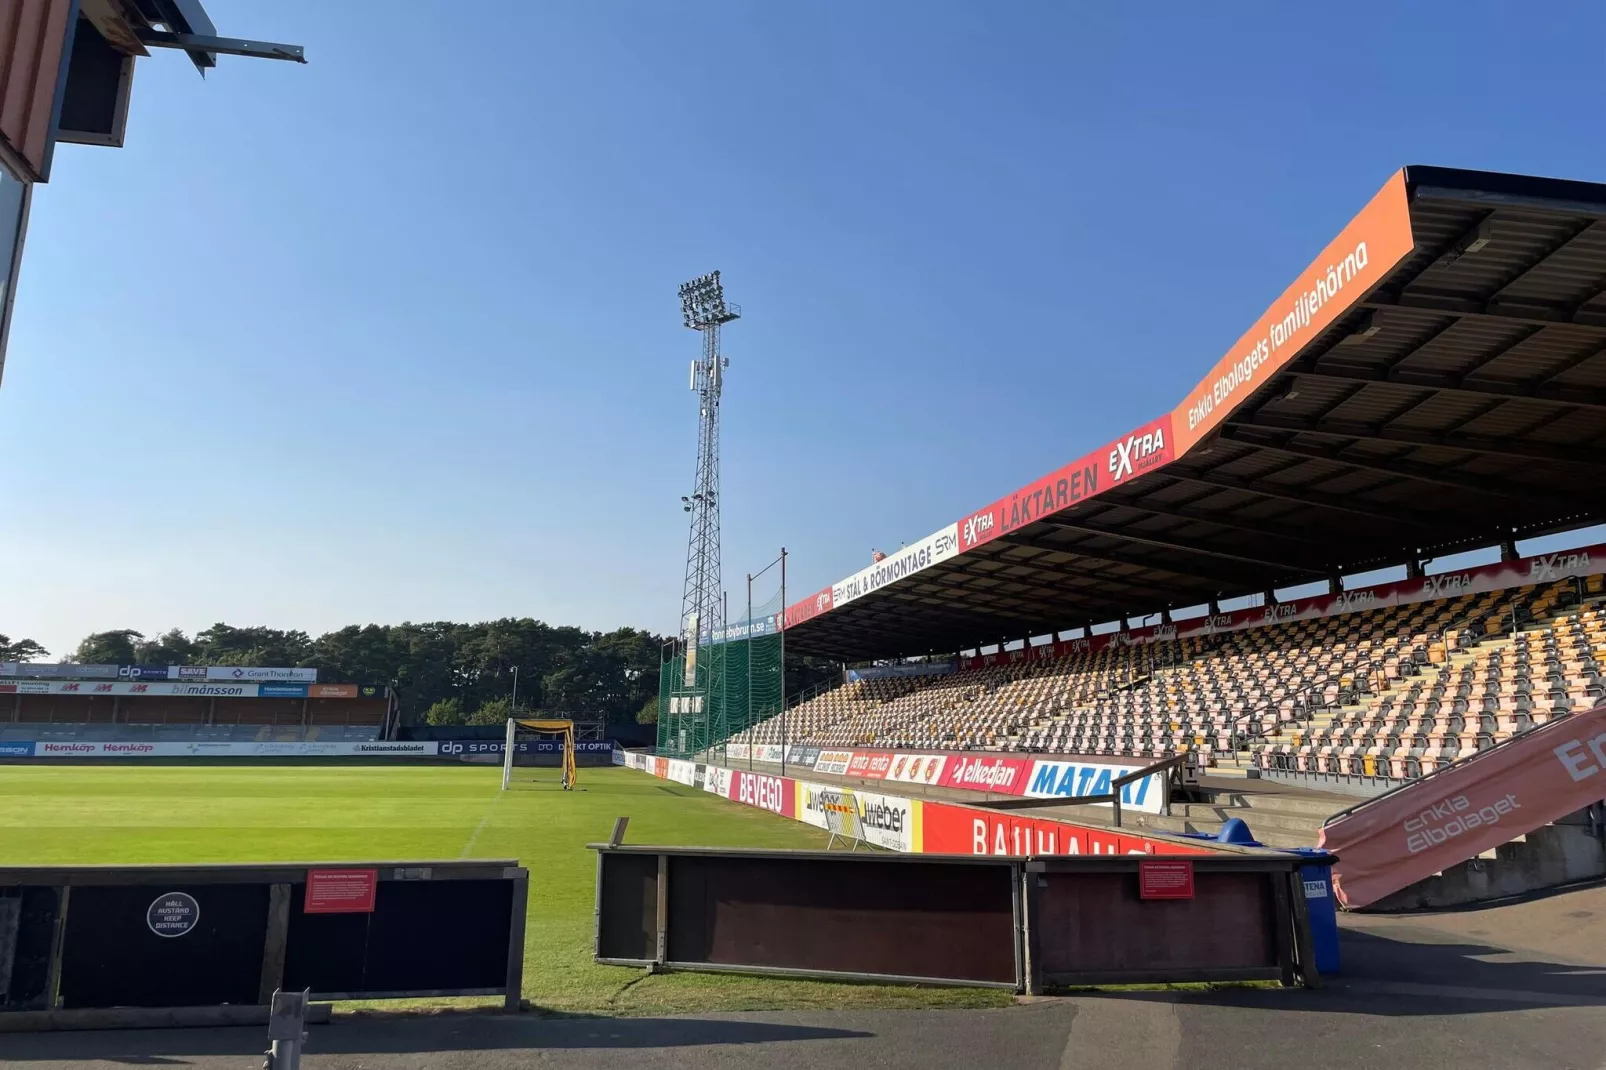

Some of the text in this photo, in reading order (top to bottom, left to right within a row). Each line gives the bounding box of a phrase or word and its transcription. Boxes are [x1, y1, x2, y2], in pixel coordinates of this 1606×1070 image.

[1189, 241, 1369, 431] Enkla Elbolagets familjehörna
[964, 428, 1165, 546] EXTRA LÄKTAREN EXTRA
[847, 577, 861, 600] STÅL
[863, 576, 869, 592] &
[870, 546, 932, 590] RÖRMONTAGE
[935, 533, 957, 556] SRM
[1530, 552, 1591, 581] EXTRA
[1422, 573, 1472, 599] EXTRA
[1336, 590, 1375, 612] EXTRA
[1204, 614, 1232, 633] EXTRA
[1264, 604, 1297, 624] EXTRA
[1154, 624, 1177, 640] EXTRA
[119, 665, 141, 678] dp
[180, 667, 206, 675] SAVE
[45, 744, 96, 752] Hemköp
[103, 744, 154, 752] Hemköp
[442, 741, 463, 754] dp
[588, 743, 611, 751] OPTIK
[964, 759, 1018, 789] elkedjan
[739, 773, 783, 814] BEVEGO
[866, 797, 906, 833] weber
[1403, 794, 1470, 833] Enkla
[1406, 793, 1522, 854] Elbolaget
